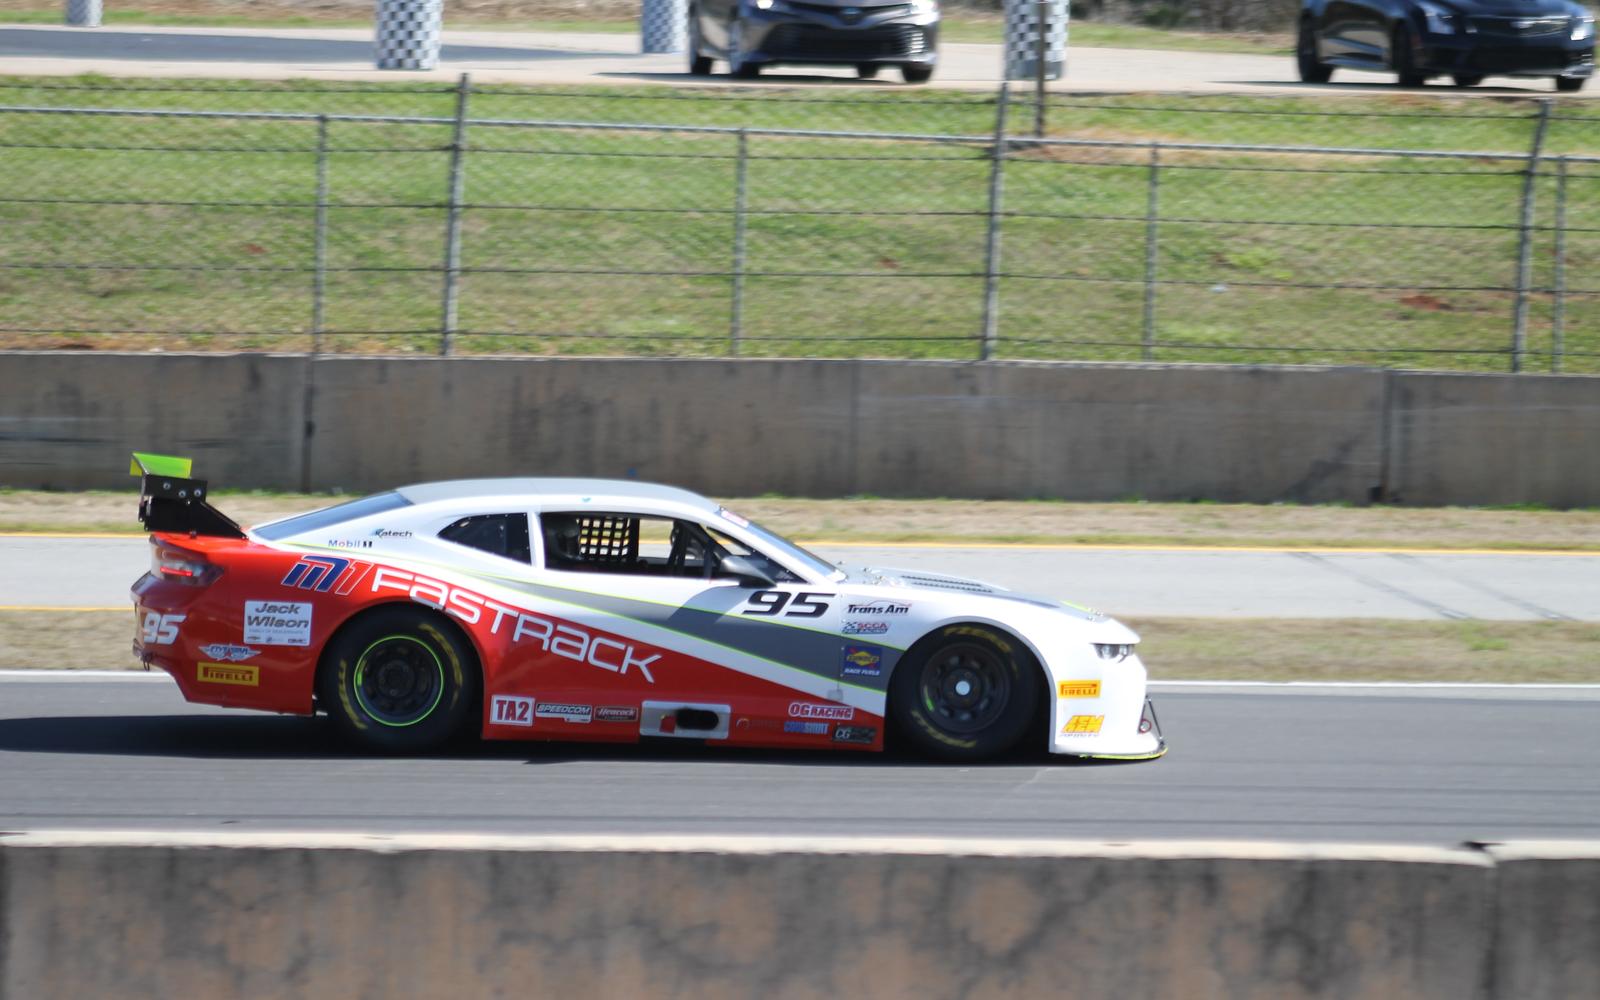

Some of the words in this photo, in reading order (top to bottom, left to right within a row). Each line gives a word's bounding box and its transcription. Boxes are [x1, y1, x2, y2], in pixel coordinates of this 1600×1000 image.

[328, 539, 361, 548] Mobil
[255, 602, 301, 615] Jack
[741, 590, 836, 618] 95
[847, 604, 883, 614] Trans
[884, 604, 909, 614] Am
[143, 612, 187, 645] 95
[247, 615, 310, 629] Wilson
[203, 666, 255, 682] PIRELLI
[1060, 683, 1098, 696] PIRELLI
[495, 699, 530, 723] TA2
[536, 704, 592, 715] SPEEDCOM
[789, 703, 810, 716] OG
[810, 705, 852, 719] RACING
